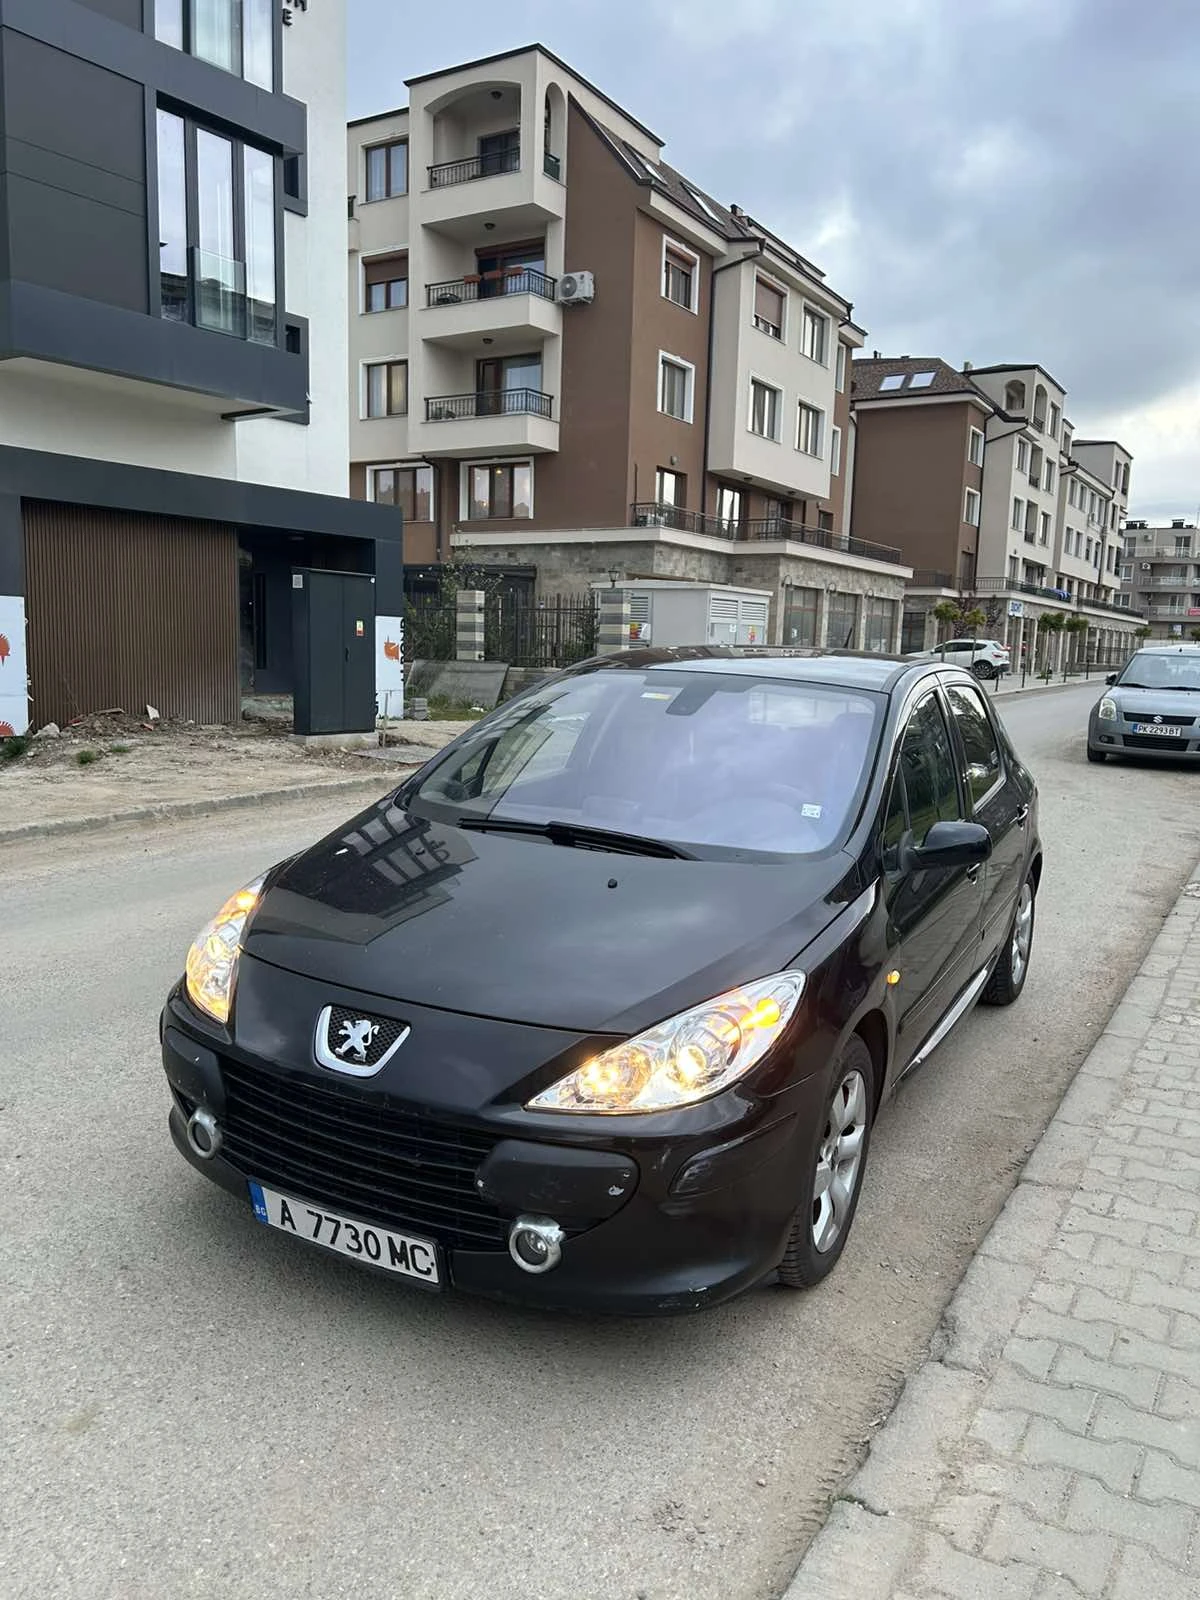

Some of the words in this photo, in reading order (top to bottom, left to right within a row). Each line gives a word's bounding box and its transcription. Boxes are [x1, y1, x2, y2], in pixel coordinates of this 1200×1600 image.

[280, 1199, 297, 1231] A
[306, 1209, 381, 1260] 7730
[387, 1235, 432, 1276] MC
